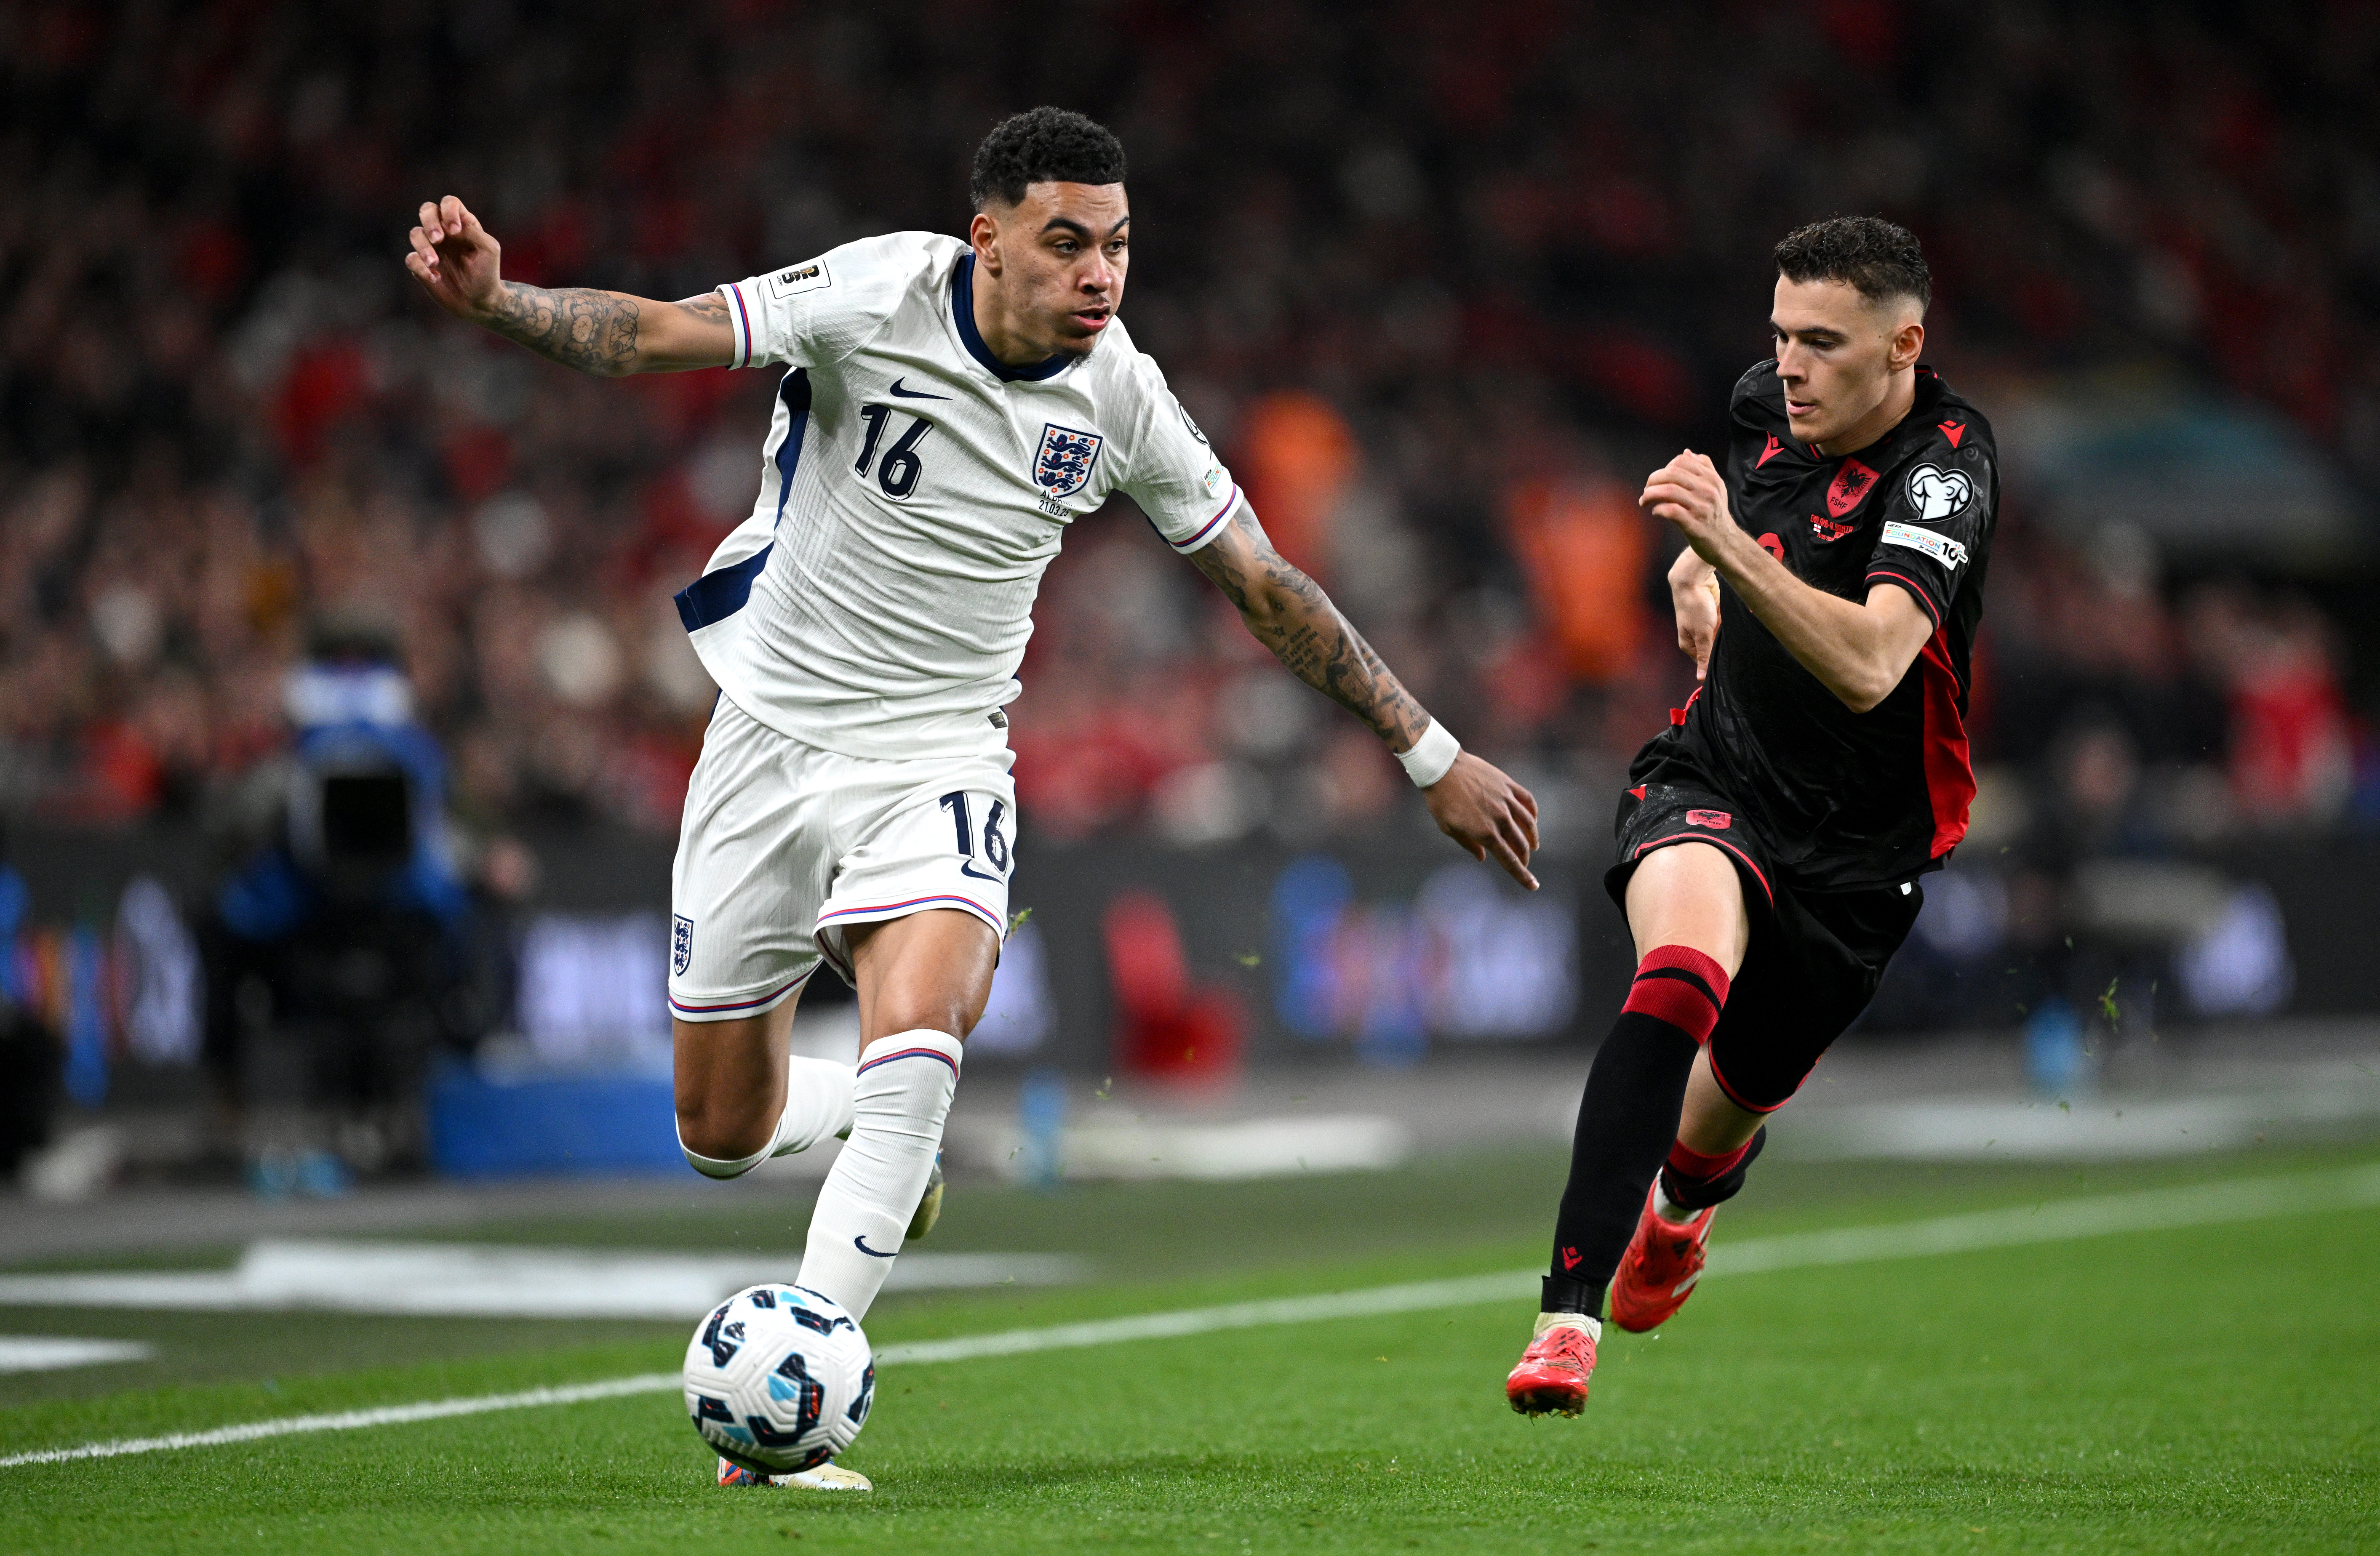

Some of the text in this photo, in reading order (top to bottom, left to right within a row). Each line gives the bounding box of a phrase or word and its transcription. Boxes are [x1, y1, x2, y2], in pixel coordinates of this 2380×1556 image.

[855, 404, 934, 501] 16
[1038, 500, 1072, 517] 21.03.25
[1830, 497, 1848, 509] FSHF
[1942, 542, 1958, 561] 10
[939, 791, 1009, 877] 16
